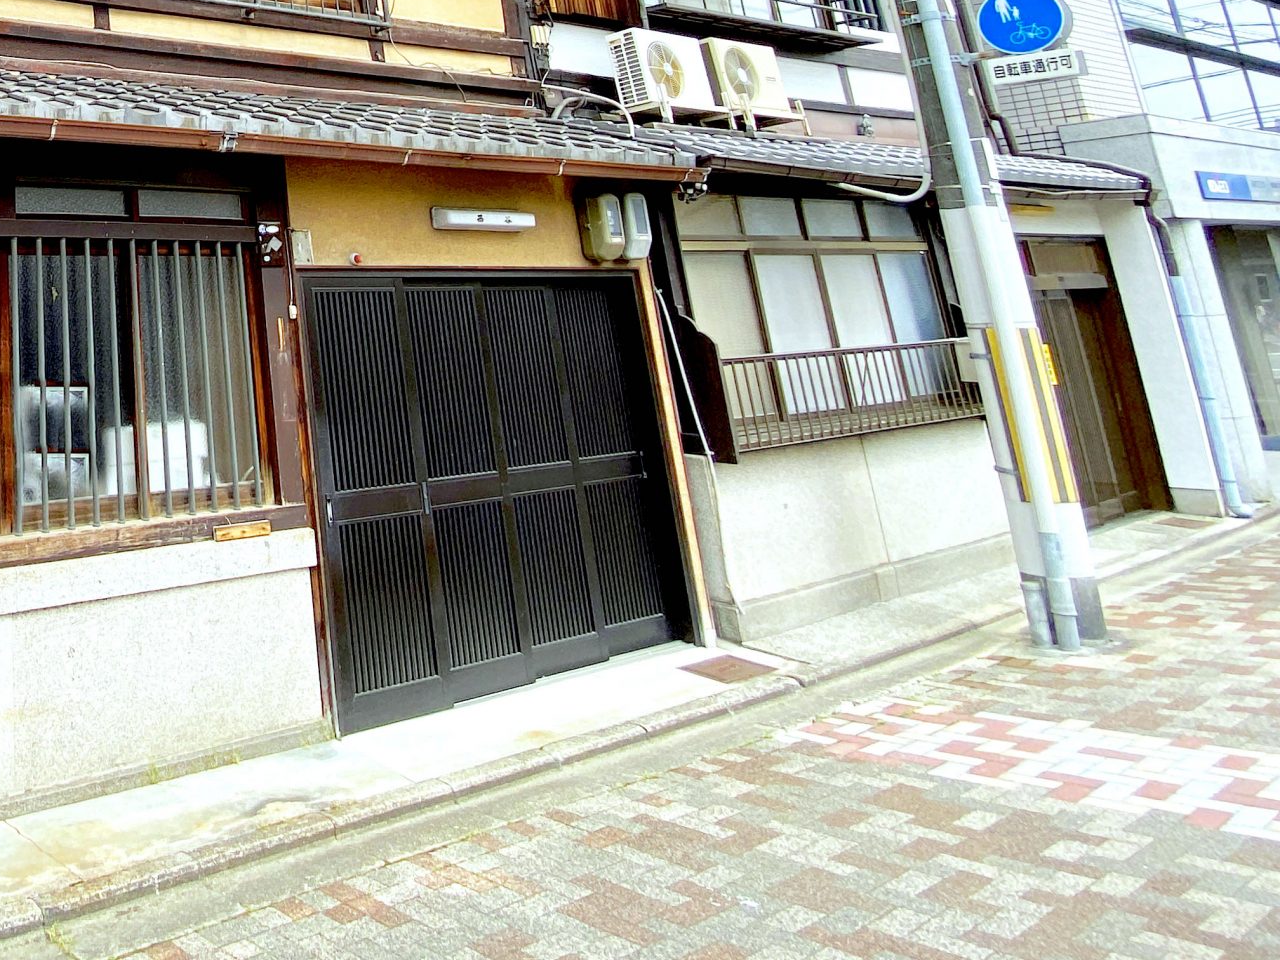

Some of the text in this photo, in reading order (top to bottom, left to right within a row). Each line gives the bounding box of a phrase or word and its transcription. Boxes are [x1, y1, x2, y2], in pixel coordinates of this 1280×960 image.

[994, 55, 1072, 78] 自転車通行可
